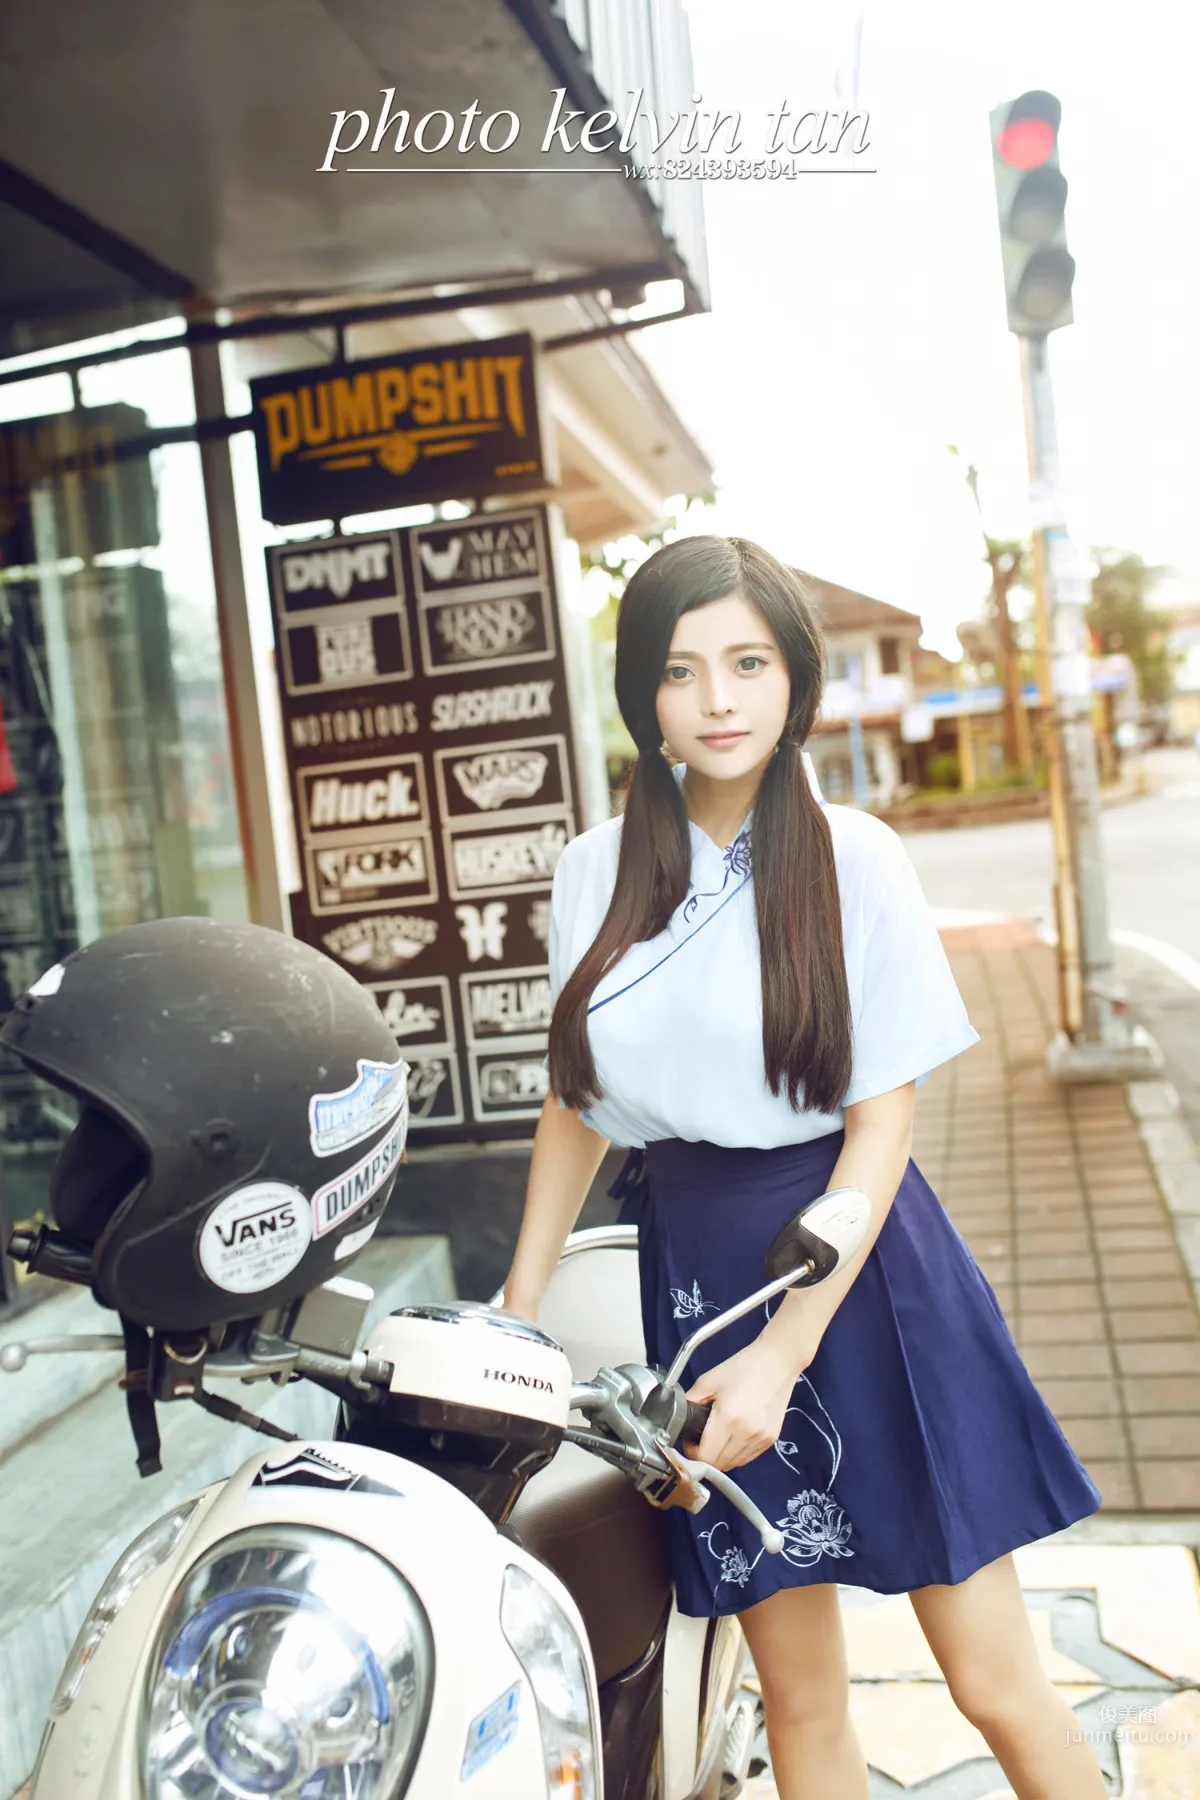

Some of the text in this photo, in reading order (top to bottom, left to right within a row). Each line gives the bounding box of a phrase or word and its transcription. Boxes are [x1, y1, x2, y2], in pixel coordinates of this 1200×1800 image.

[260, 355, 525, 472] DUMPSHIT
[291, 701, 419, 748] NOTORIOUS
[215, 1201, 296, 1248] VANS
[484, 1368, 554, 1393] HONDA
